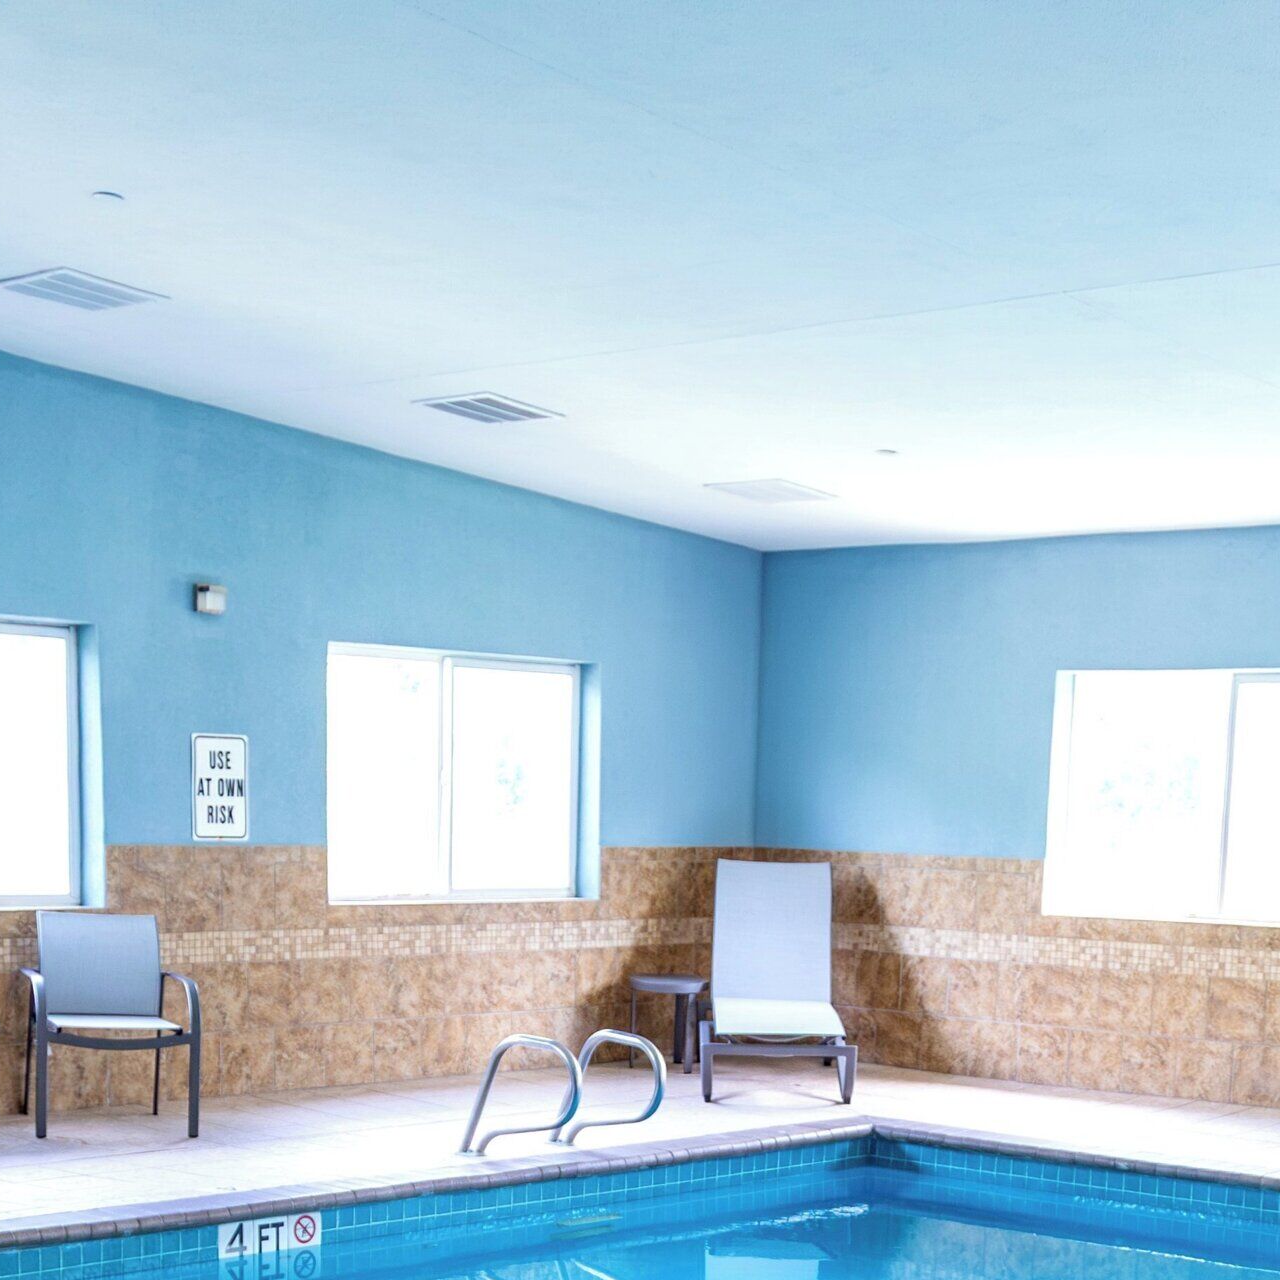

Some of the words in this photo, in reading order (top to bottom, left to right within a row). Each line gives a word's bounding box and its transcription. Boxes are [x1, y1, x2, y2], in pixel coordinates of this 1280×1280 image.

[209, 750, 231, 770] USE
[197, 777, 212, 796] AT
[218, 778, 244, 797] OWN
[207, 805, 234, 824] RISK
[225, 1222, 247, 1257] 4
[258, 1221, 284, 1253] FT
